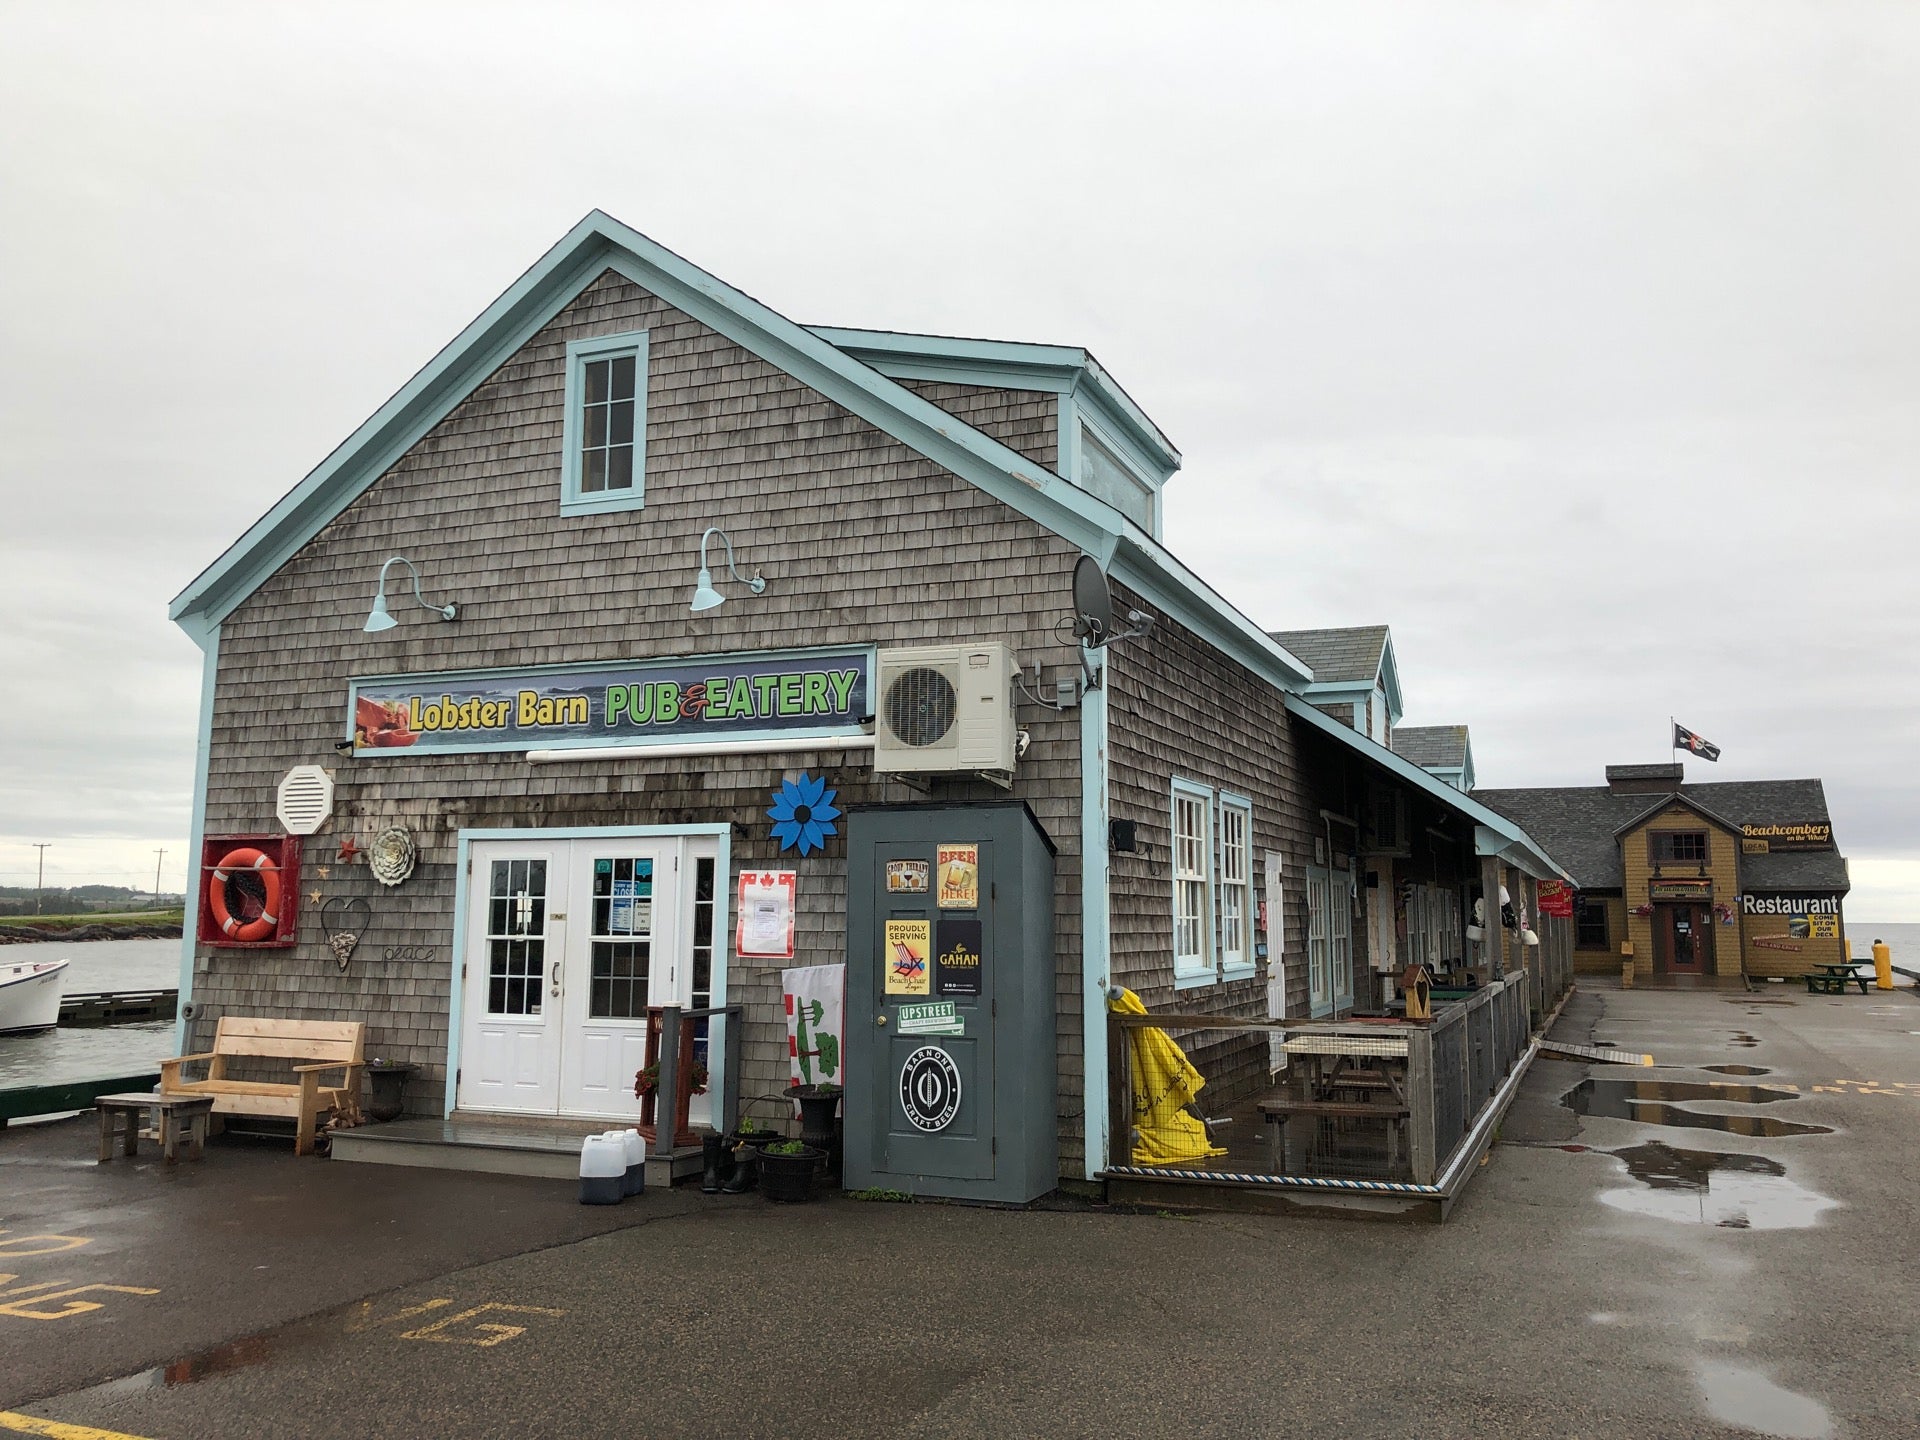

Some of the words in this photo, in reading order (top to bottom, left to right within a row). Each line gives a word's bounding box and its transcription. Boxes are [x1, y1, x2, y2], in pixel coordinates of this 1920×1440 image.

[408, 694, 511, 732] Lobster
[517, 690, 589, 727] Barn
[605, 682, 680, 726] PUB
[705, 670, 859, 719] EATERY
[1742, 823, 1830, 836] Beachcombers
[1806, 834, 1828, 842] Wharf
[939, 850, 976, 865] BEER
[887, 863, 904, 875] GROUP
[906, 862, 929, 874] THERAPY
[941, 888, 974, 900] HERE!
[1743, 894, 1839, 914] Restaurant
[940, 954, 979, 966] GAHAN
[889, 975, 908, 984] Beach
[909, 975, 926, 984] Chair
[902, 1004, 952, 1019] UPSTREET
[906, 1049, 953, 1073] BARNONE
[906, 1103, 931, 1128] CRAFT
[934, 1105, 954, 1128] BEER
